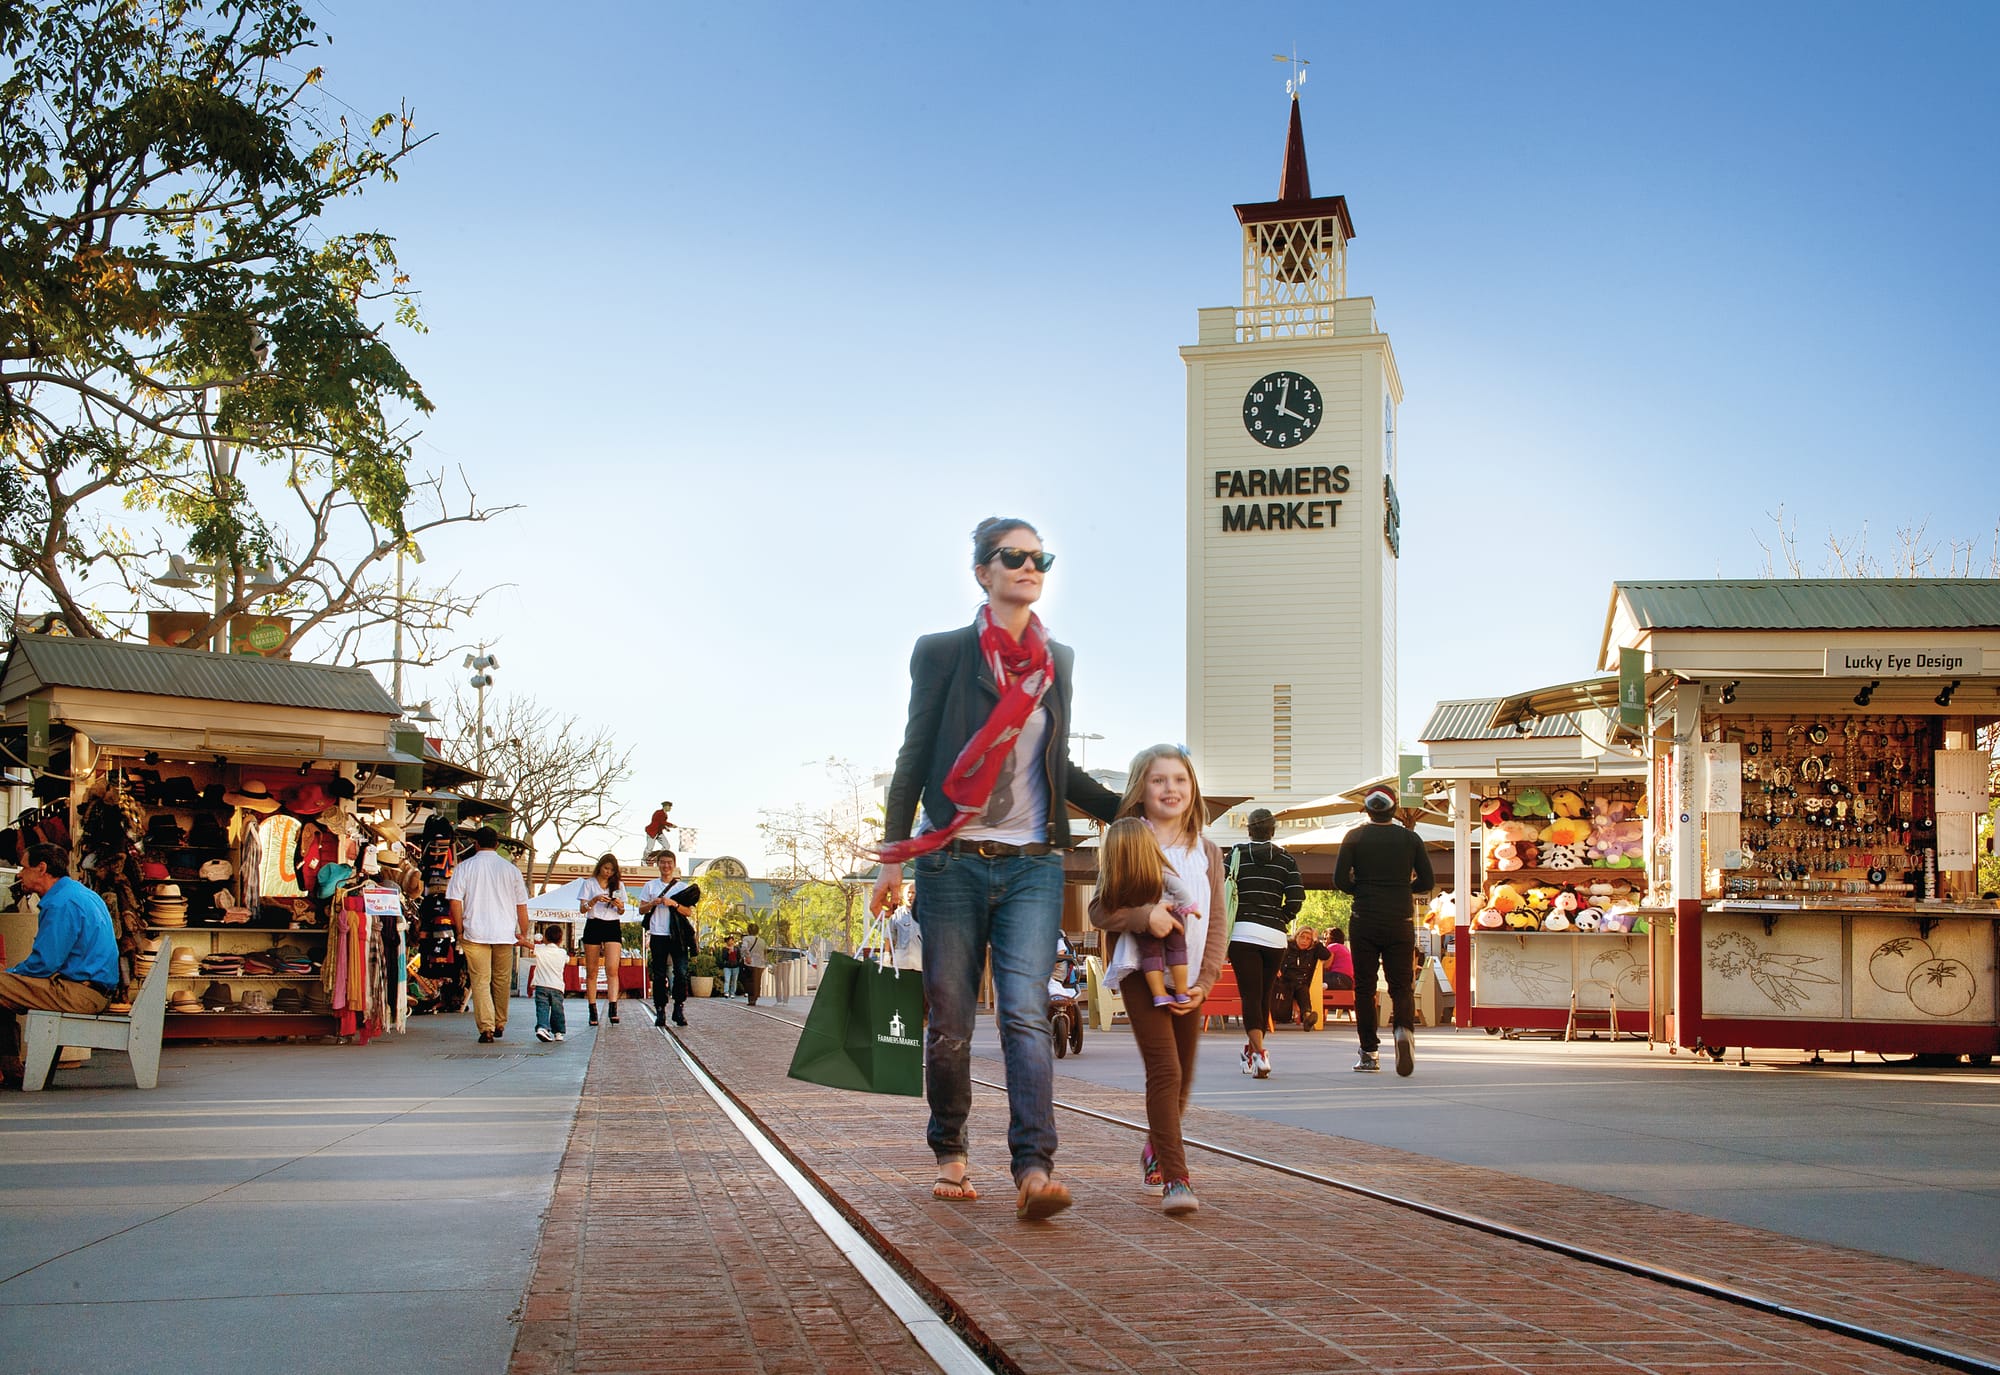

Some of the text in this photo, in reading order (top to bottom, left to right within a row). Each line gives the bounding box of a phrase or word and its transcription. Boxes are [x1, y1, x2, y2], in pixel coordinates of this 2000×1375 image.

[1265, 382, 1273, 392] 11
[1277, 377, 1289, 388] 12
[1253, 392, 1264, 403] 10
[1303, 390, 1312, 400] 2
[1250, 406, 1259, 417] 9
[1307, 403, 1315, 413] 3
[1254, 420, 1262, 430] 8
[1303, 418, 1311, 428] 4
[1265, 430, 1273, 440] 7
[1278, 432, 1286, 443] 6
[1293, 428, 1301, 438] 5
[1215, 465, 1350, 498] FARMERS
[1222, 500, 1342, 532] MARKET
[1845, 654, 1962, 671] Lucky Eye Design
[1227, 812, 1324, 829] TAHEN
[568, 865, 638, 876] GILRE
[877, 1033, 899, 1044] FARMERS
